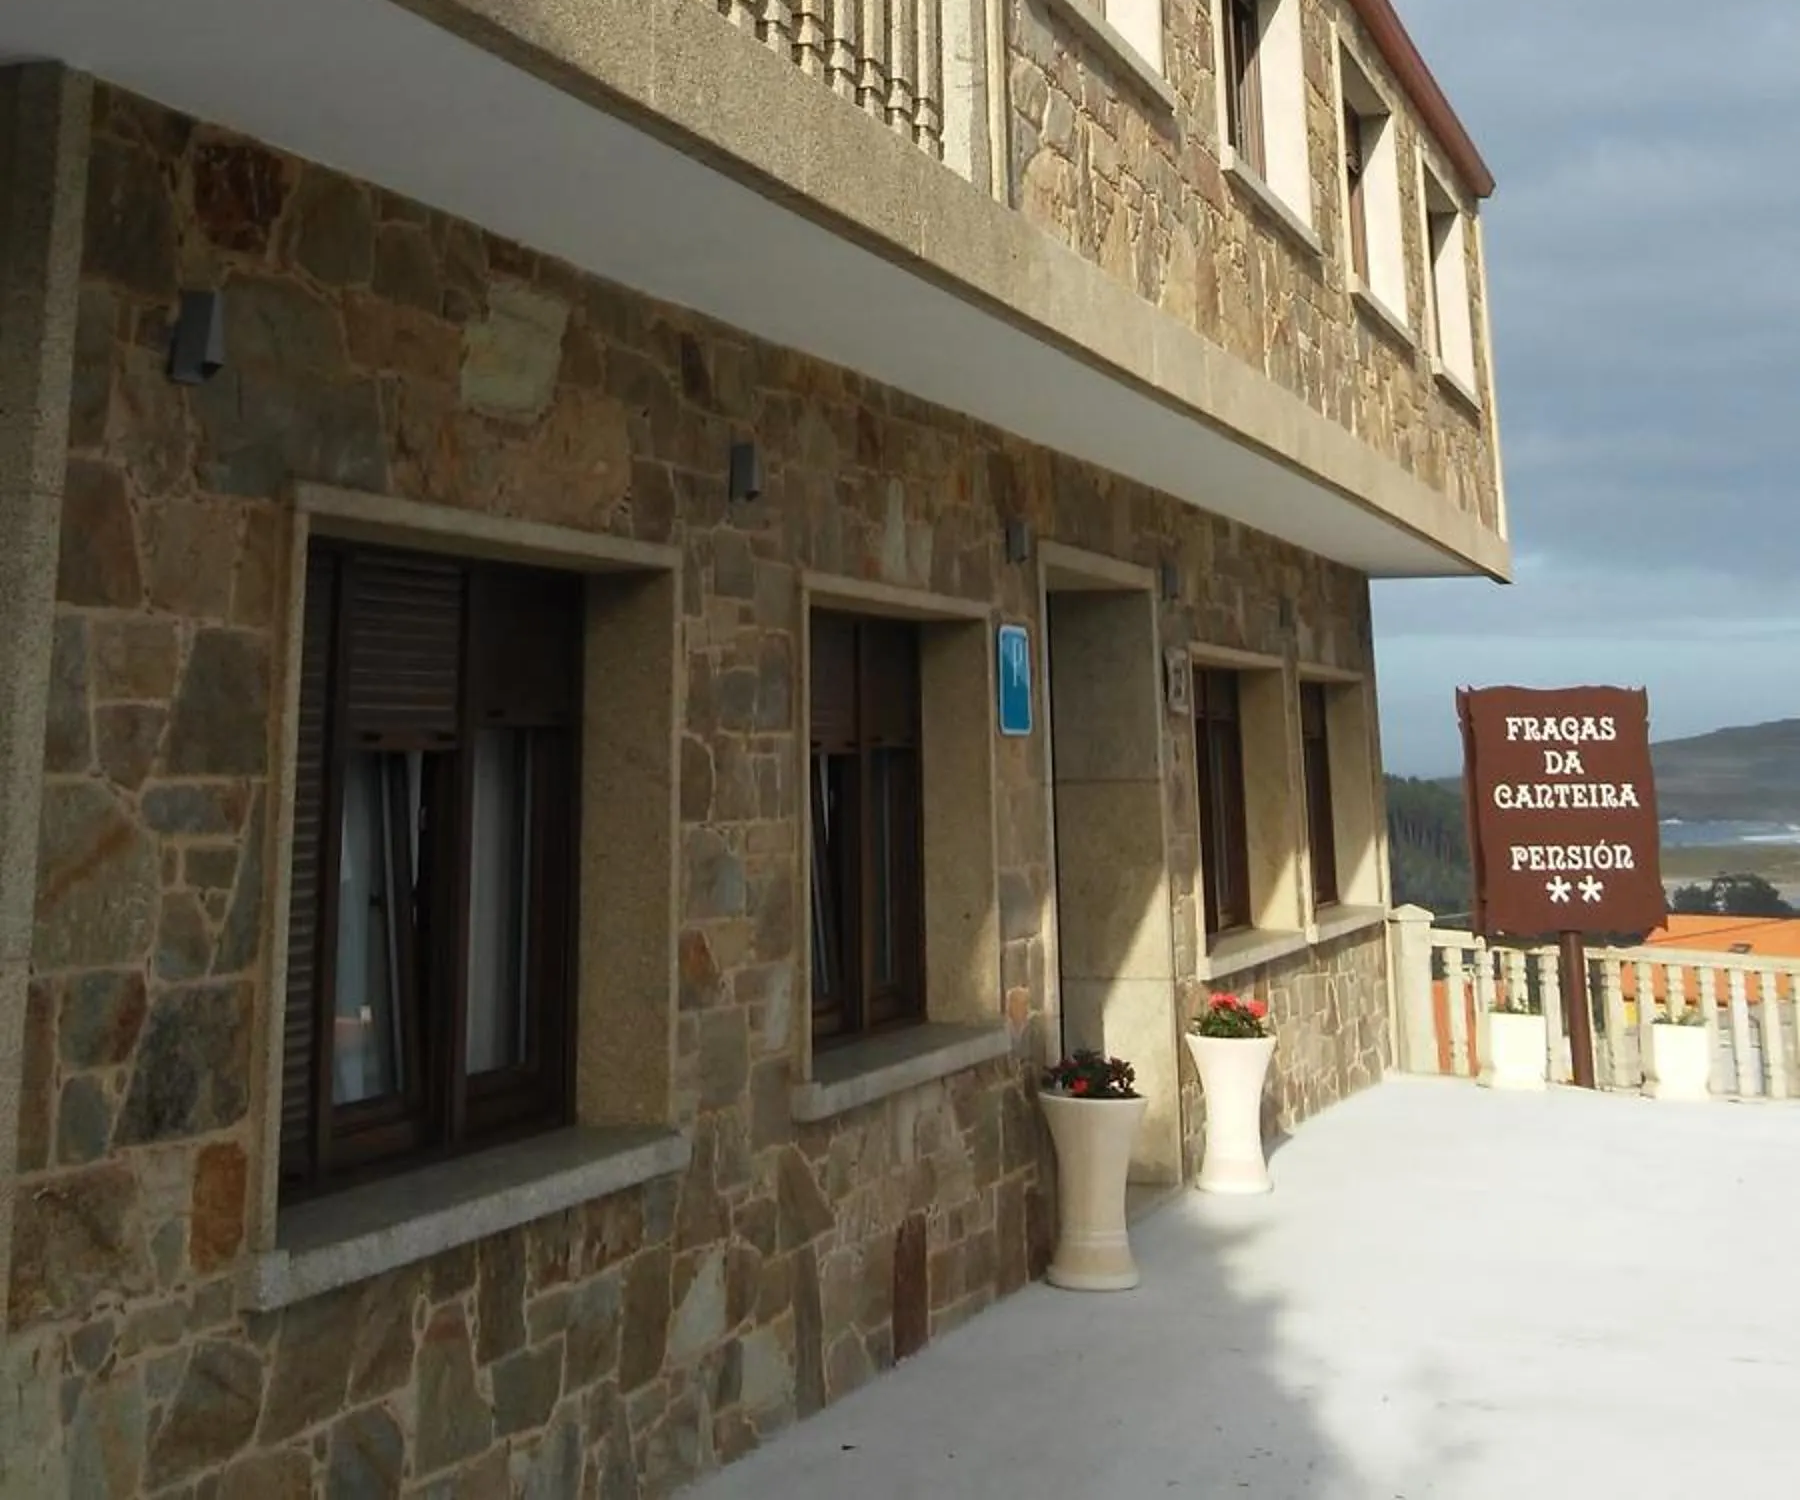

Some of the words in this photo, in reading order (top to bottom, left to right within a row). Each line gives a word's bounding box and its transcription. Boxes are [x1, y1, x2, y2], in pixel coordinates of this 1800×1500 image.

[1506, 716, 1617, 744] FRAGAS
[1544, 750, 1585, 775] DA
[1493, 783, 1640, 809] CANTEIRA
[1510, 839, 1635, 871] PENSIÓN
